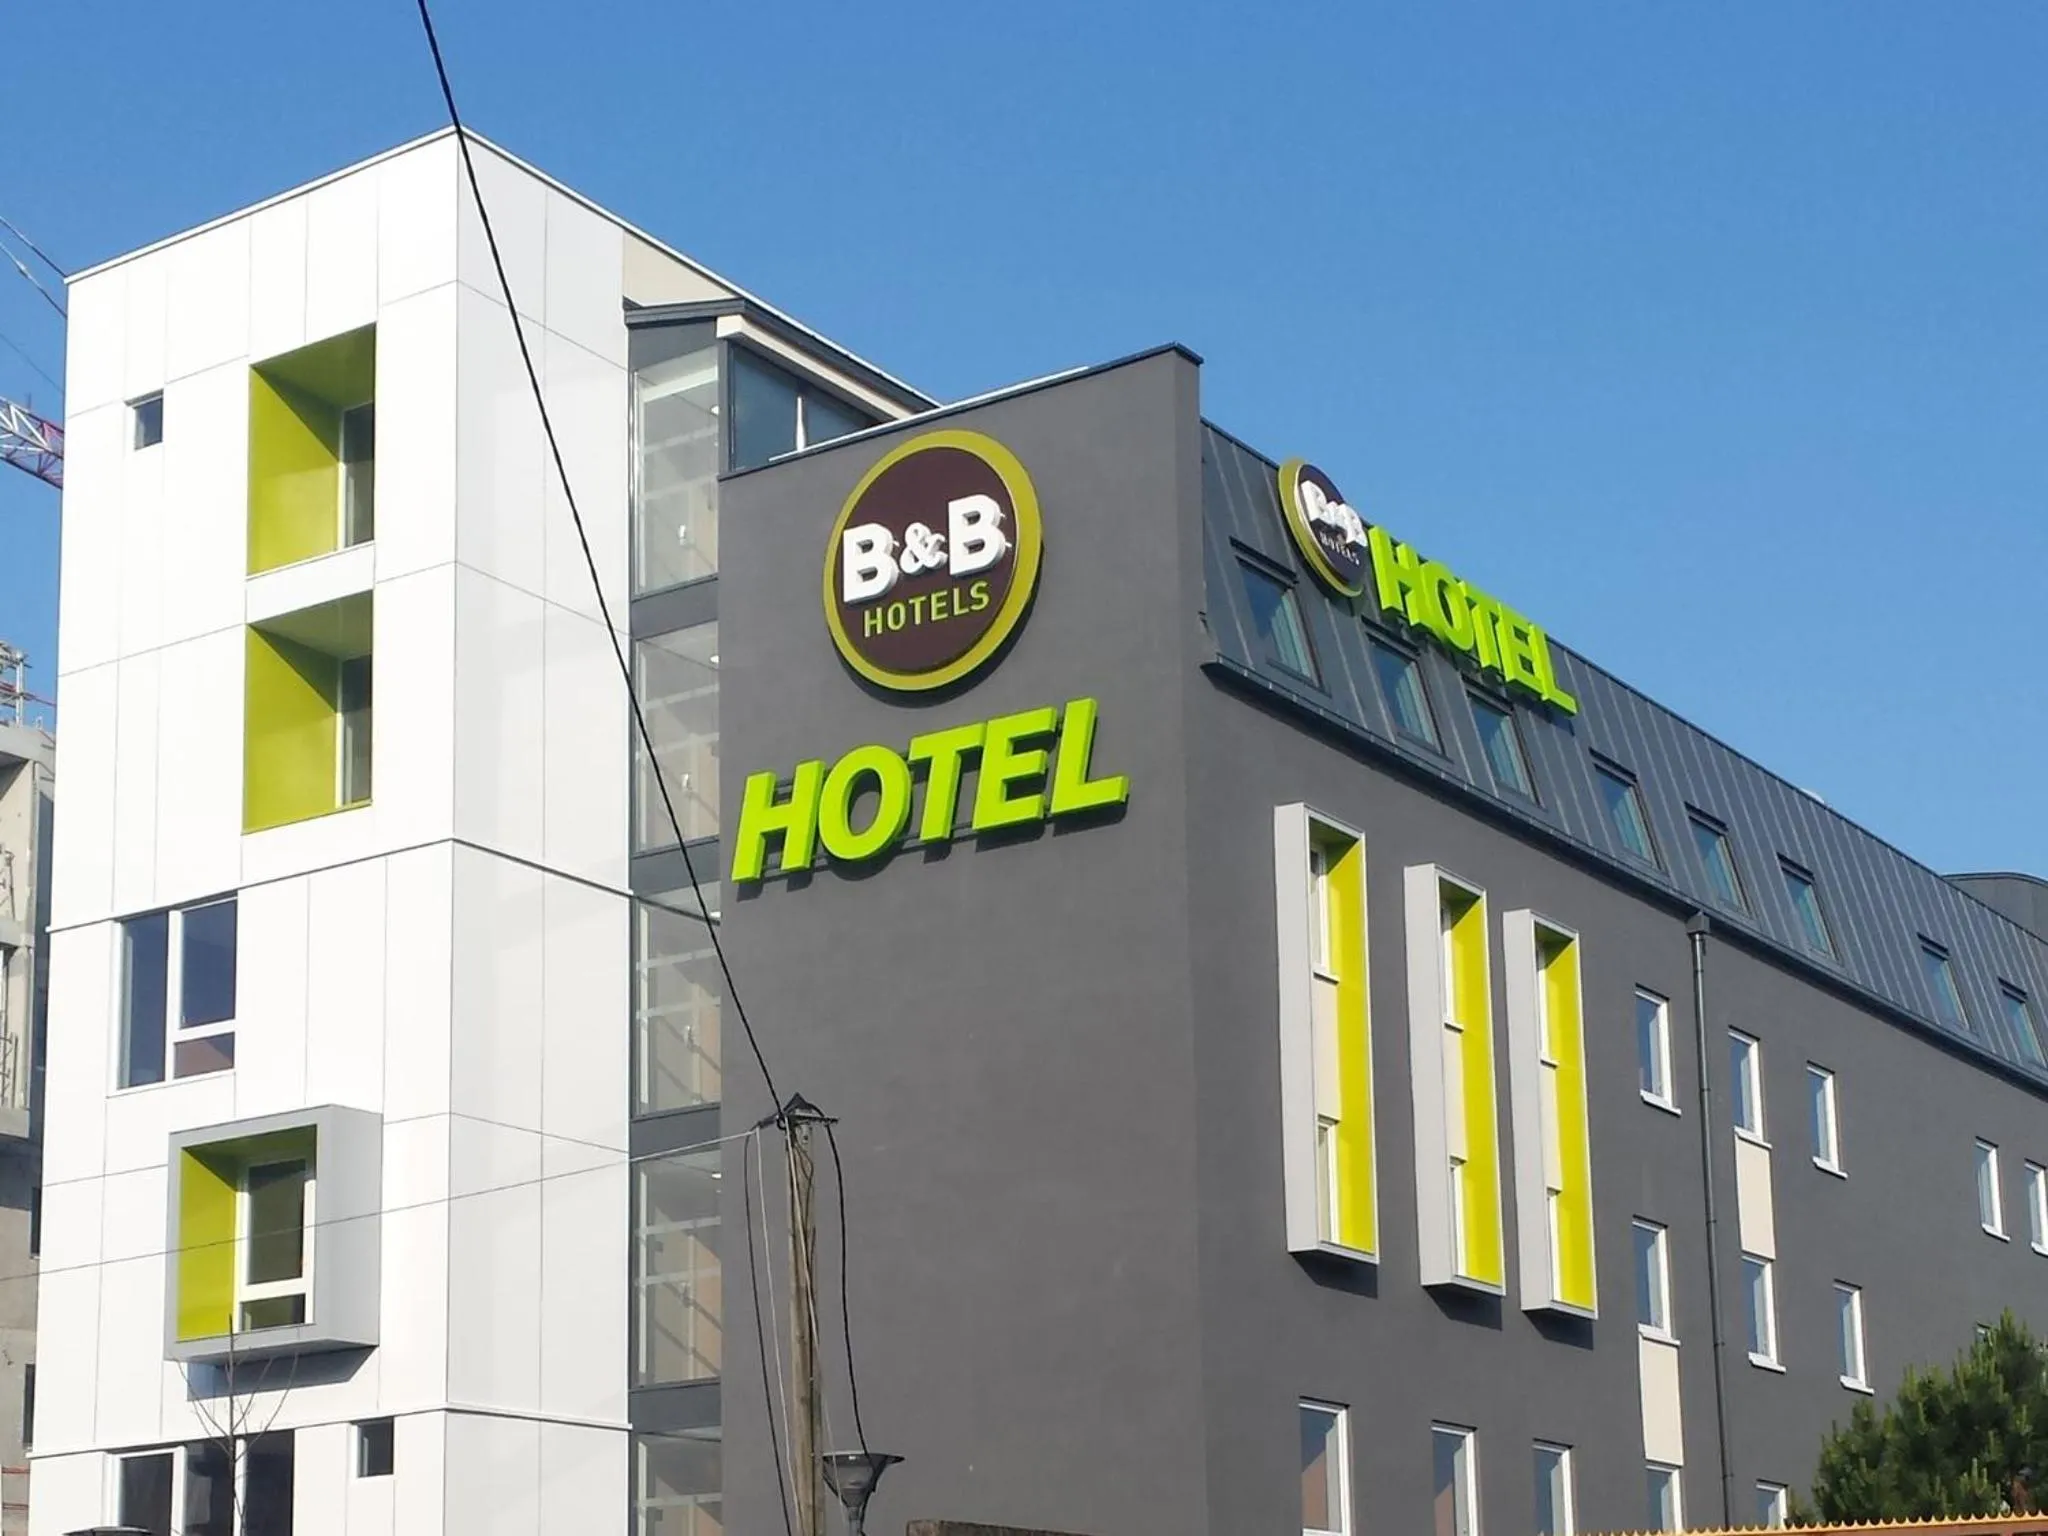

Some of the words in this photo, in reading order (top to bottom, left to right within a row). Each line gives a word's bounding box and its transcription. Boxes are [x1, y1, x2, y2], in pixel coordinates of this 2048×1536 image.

[842, 494, 1010, 603] B&B
[862, 581, 991, 638] HOTELS
[1368, 525, 1578, 716] HOTEL
[731, 697, 1129, 883] HOTEL
